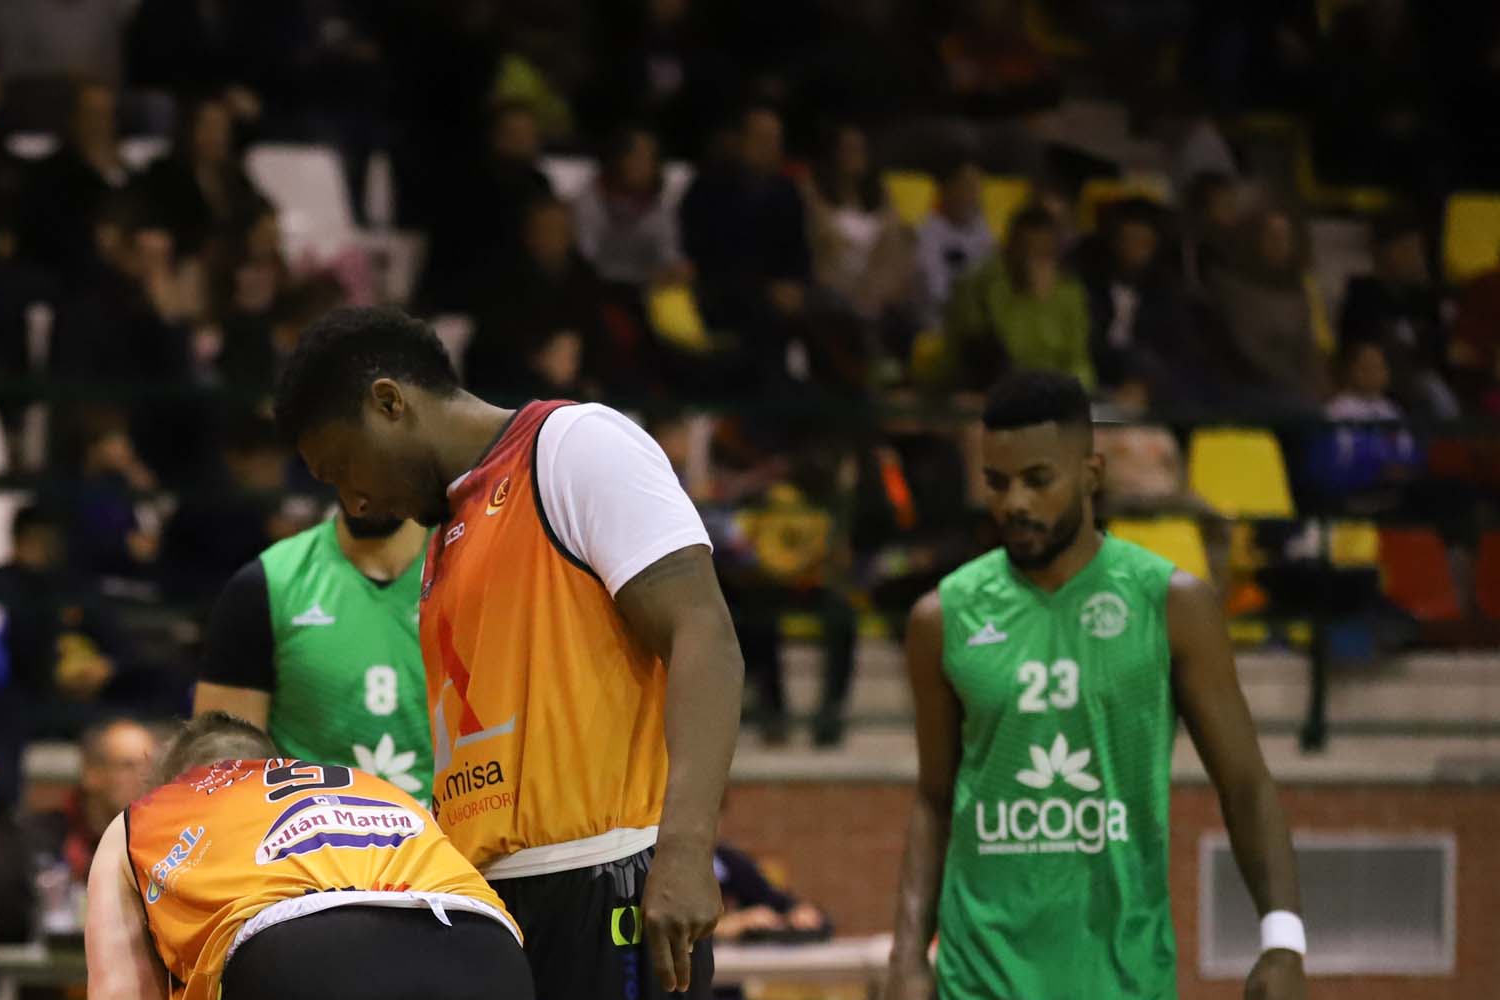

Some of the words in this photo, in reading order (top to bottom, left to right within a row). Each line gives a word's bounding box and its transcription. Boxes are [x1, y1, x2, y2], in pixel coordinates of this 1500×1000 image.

[364, 665, 399, 716] 8
[1018, 659, 1080, 713] 23
[333, 809, 413, 829] Martín
[975, 797, 1129, 854] ucoga
